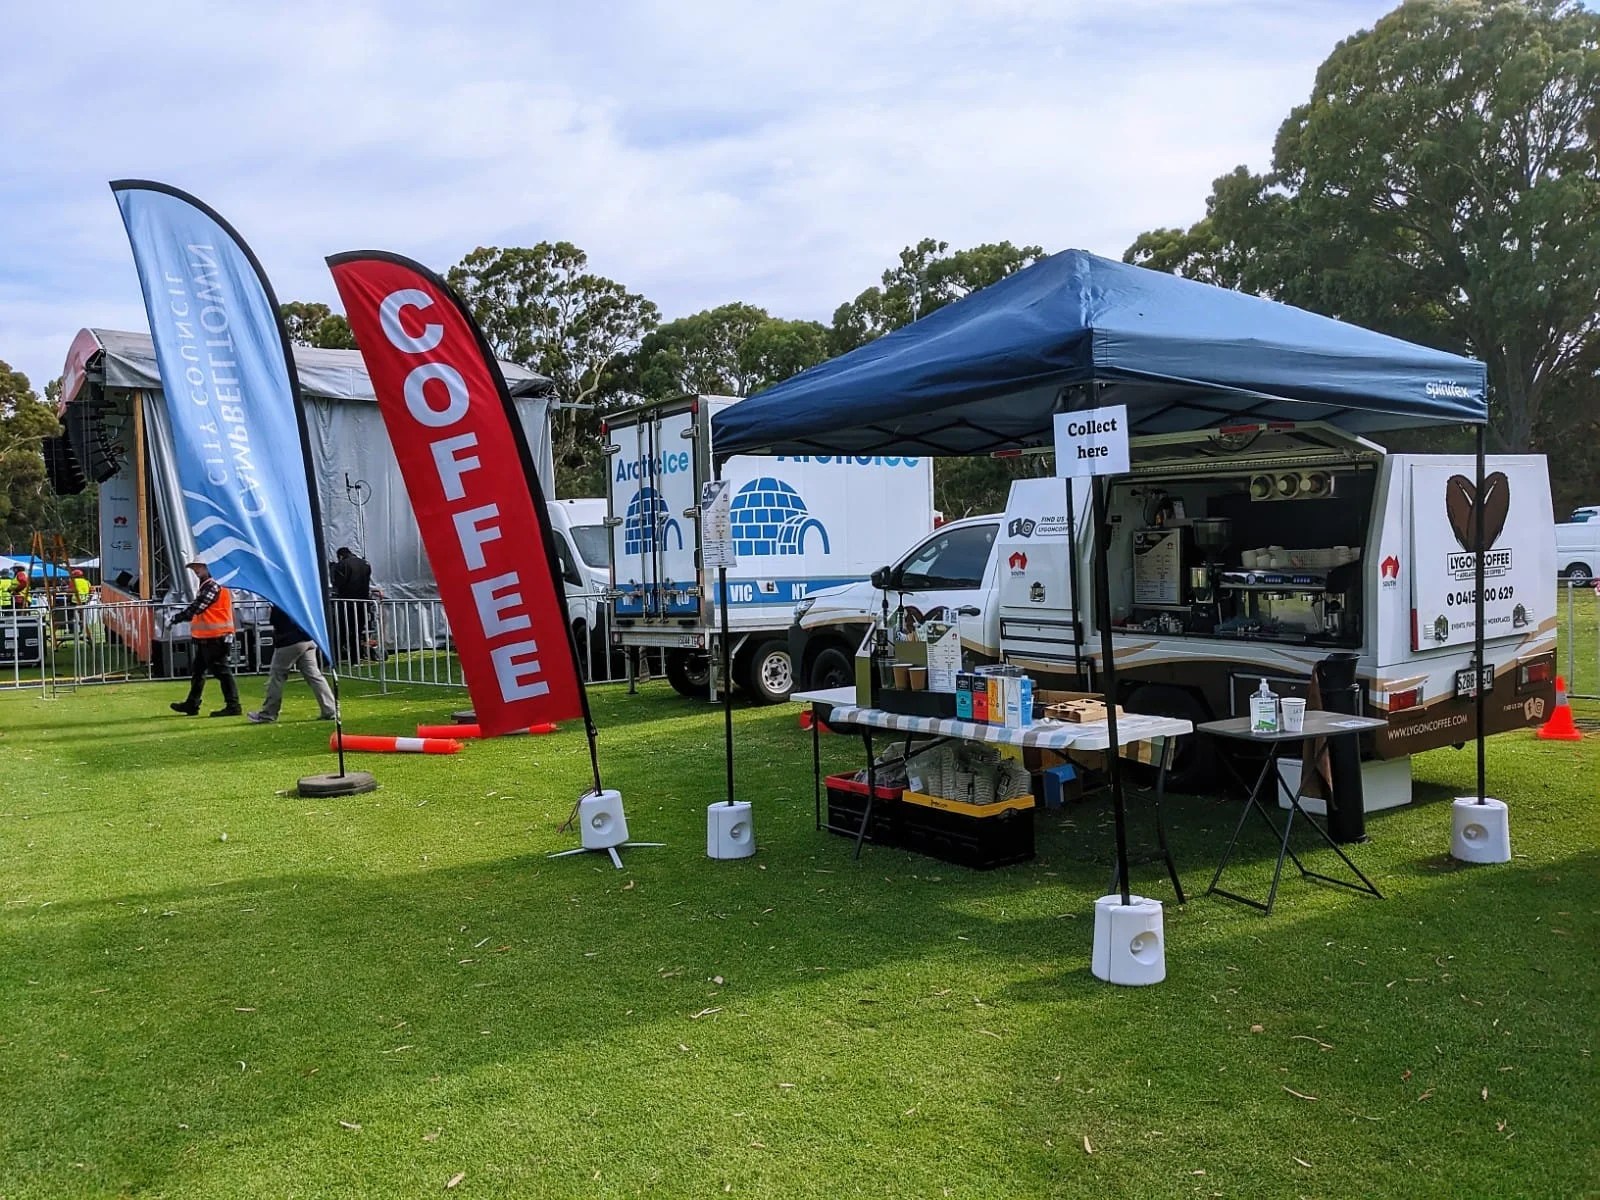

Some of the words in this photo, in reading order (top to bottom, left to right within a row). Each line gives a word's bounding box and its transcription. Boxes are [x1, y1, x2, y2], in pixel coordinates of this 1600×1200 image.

[1067, 418, 1118, 437] Collect
[1077, 445, 1109, 459] here
[379, 288, 549, 703] COFFEE
[1038, 525, 1069, 533] LYGONCOFF
[729, 584, 753, 602] VIC
[791, 583, 808, 600] NT
[1455, 590, 1477, 605] 0415
[1482, 588, 1496, 602] 00
[1498, 586, 1514, 600] 629
[1387, 714, 1468, 740] WWW.LYGONCOFFEE.COM
